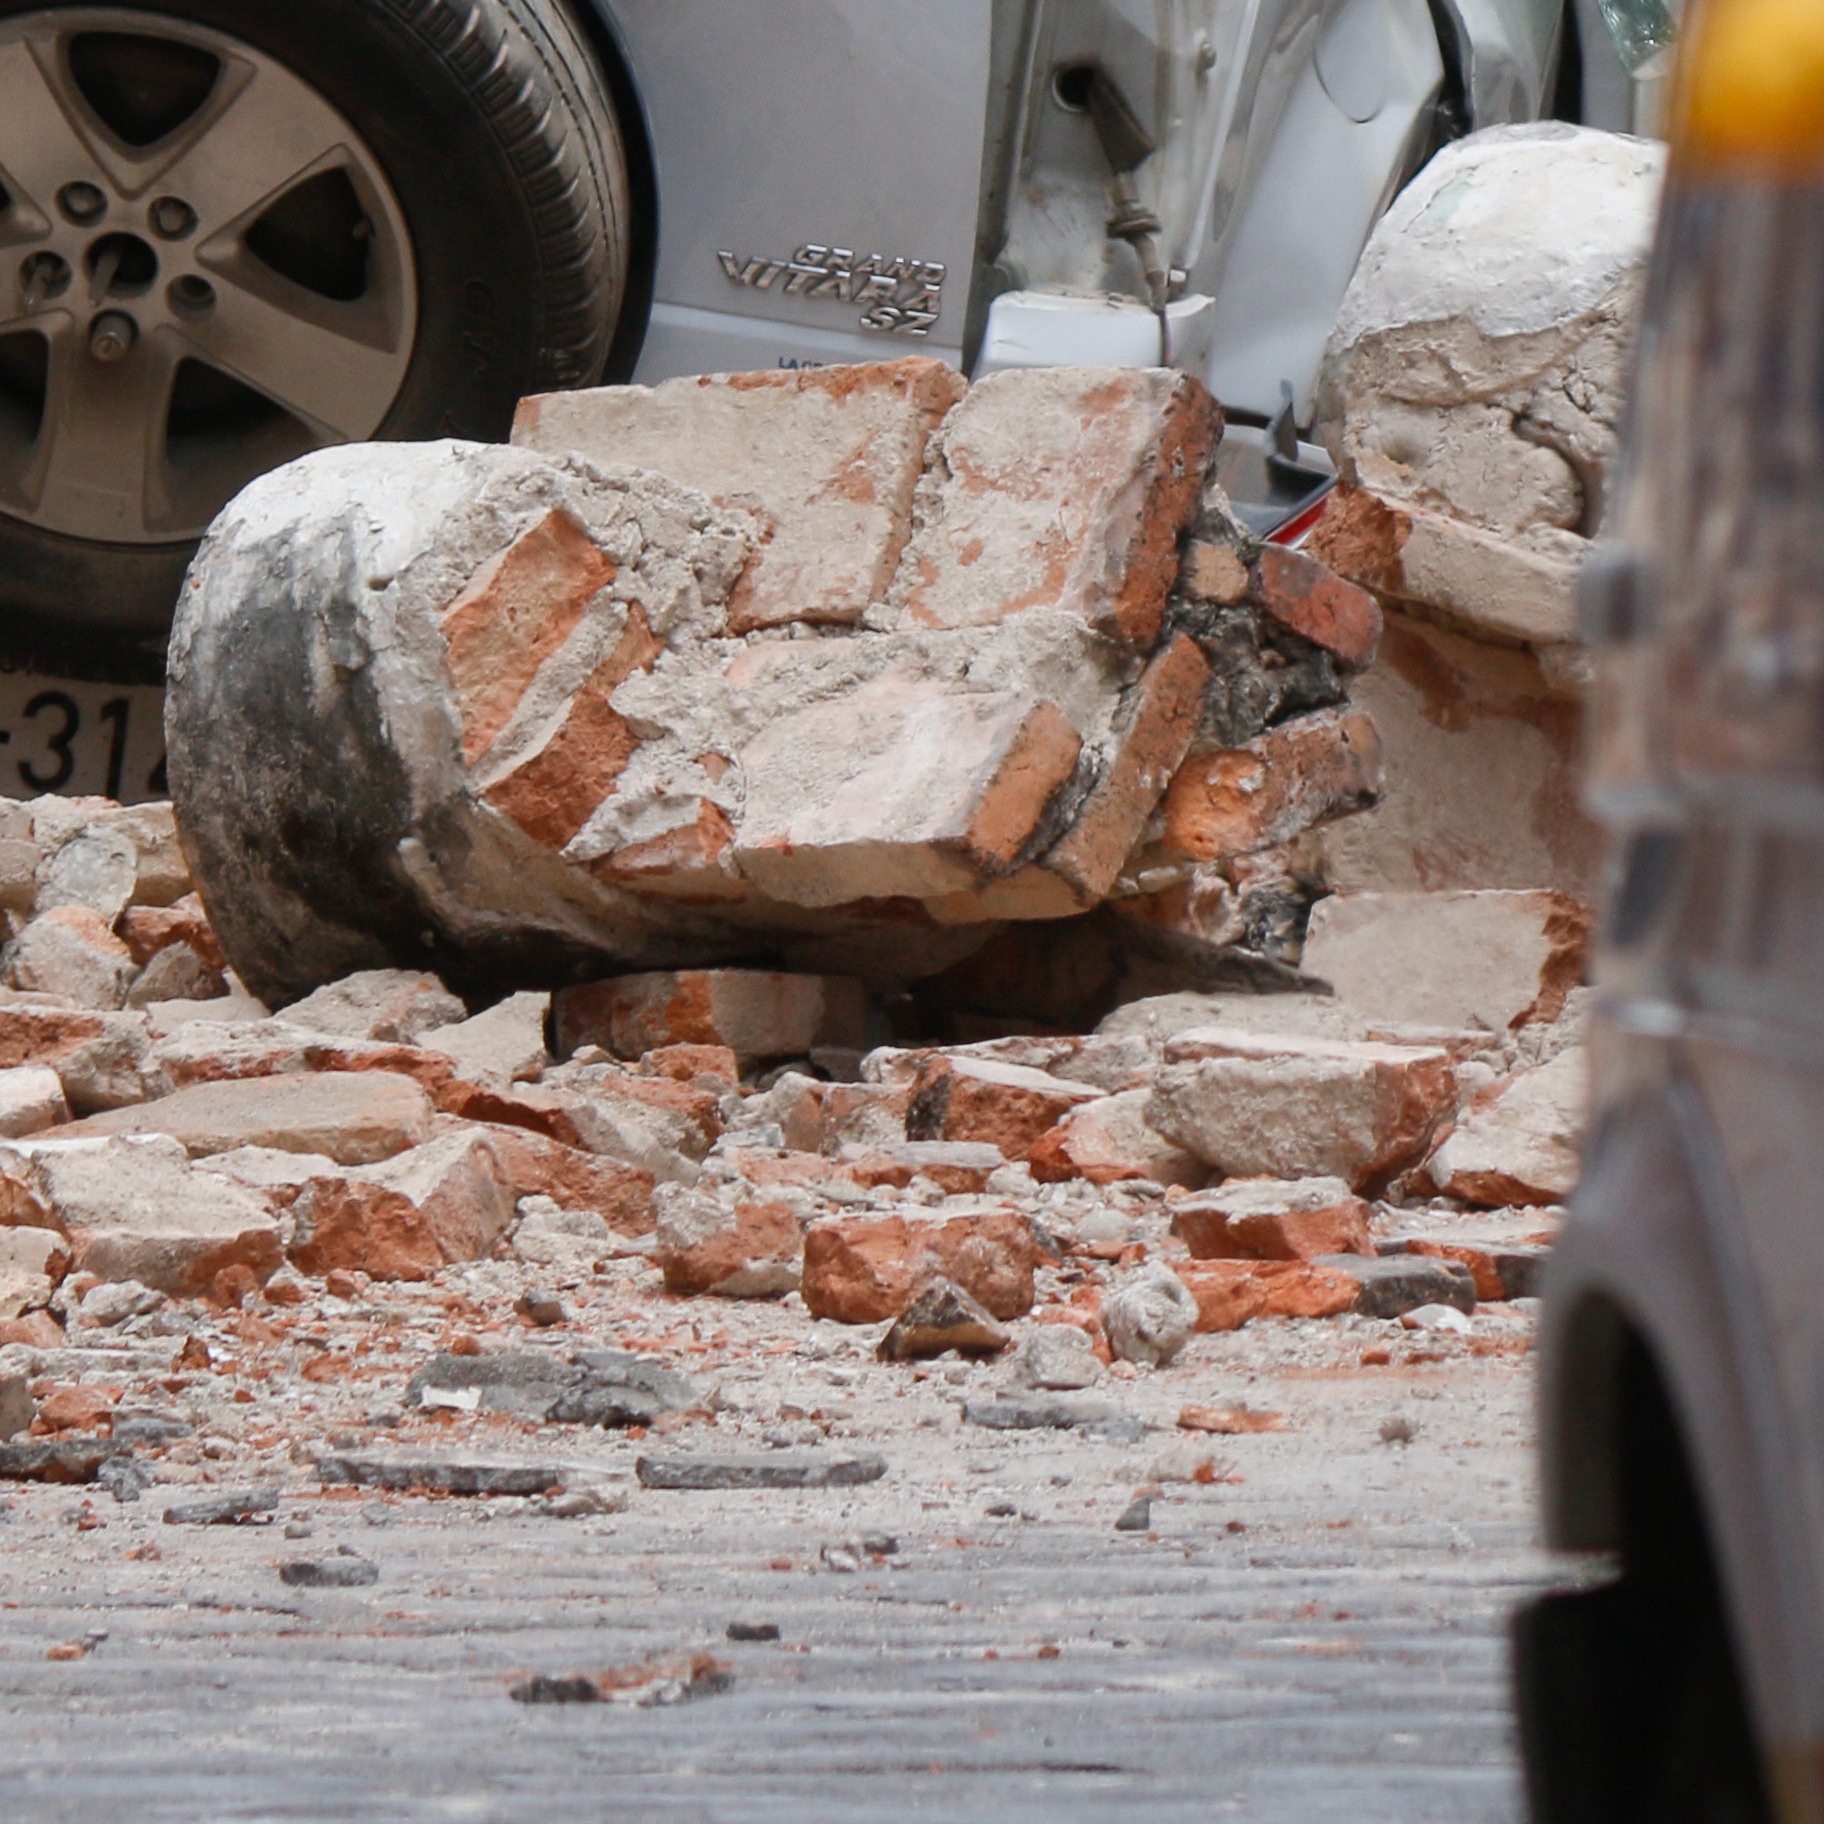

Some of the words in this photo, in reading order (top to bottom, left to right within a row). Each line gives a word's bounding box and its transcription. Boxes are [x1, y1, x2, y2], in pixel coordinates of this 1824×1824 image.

[716, 249, 942, 314] VITARA
[792, 243, 947, 284] GRAND
[859, 305, 940, 336] SZ
